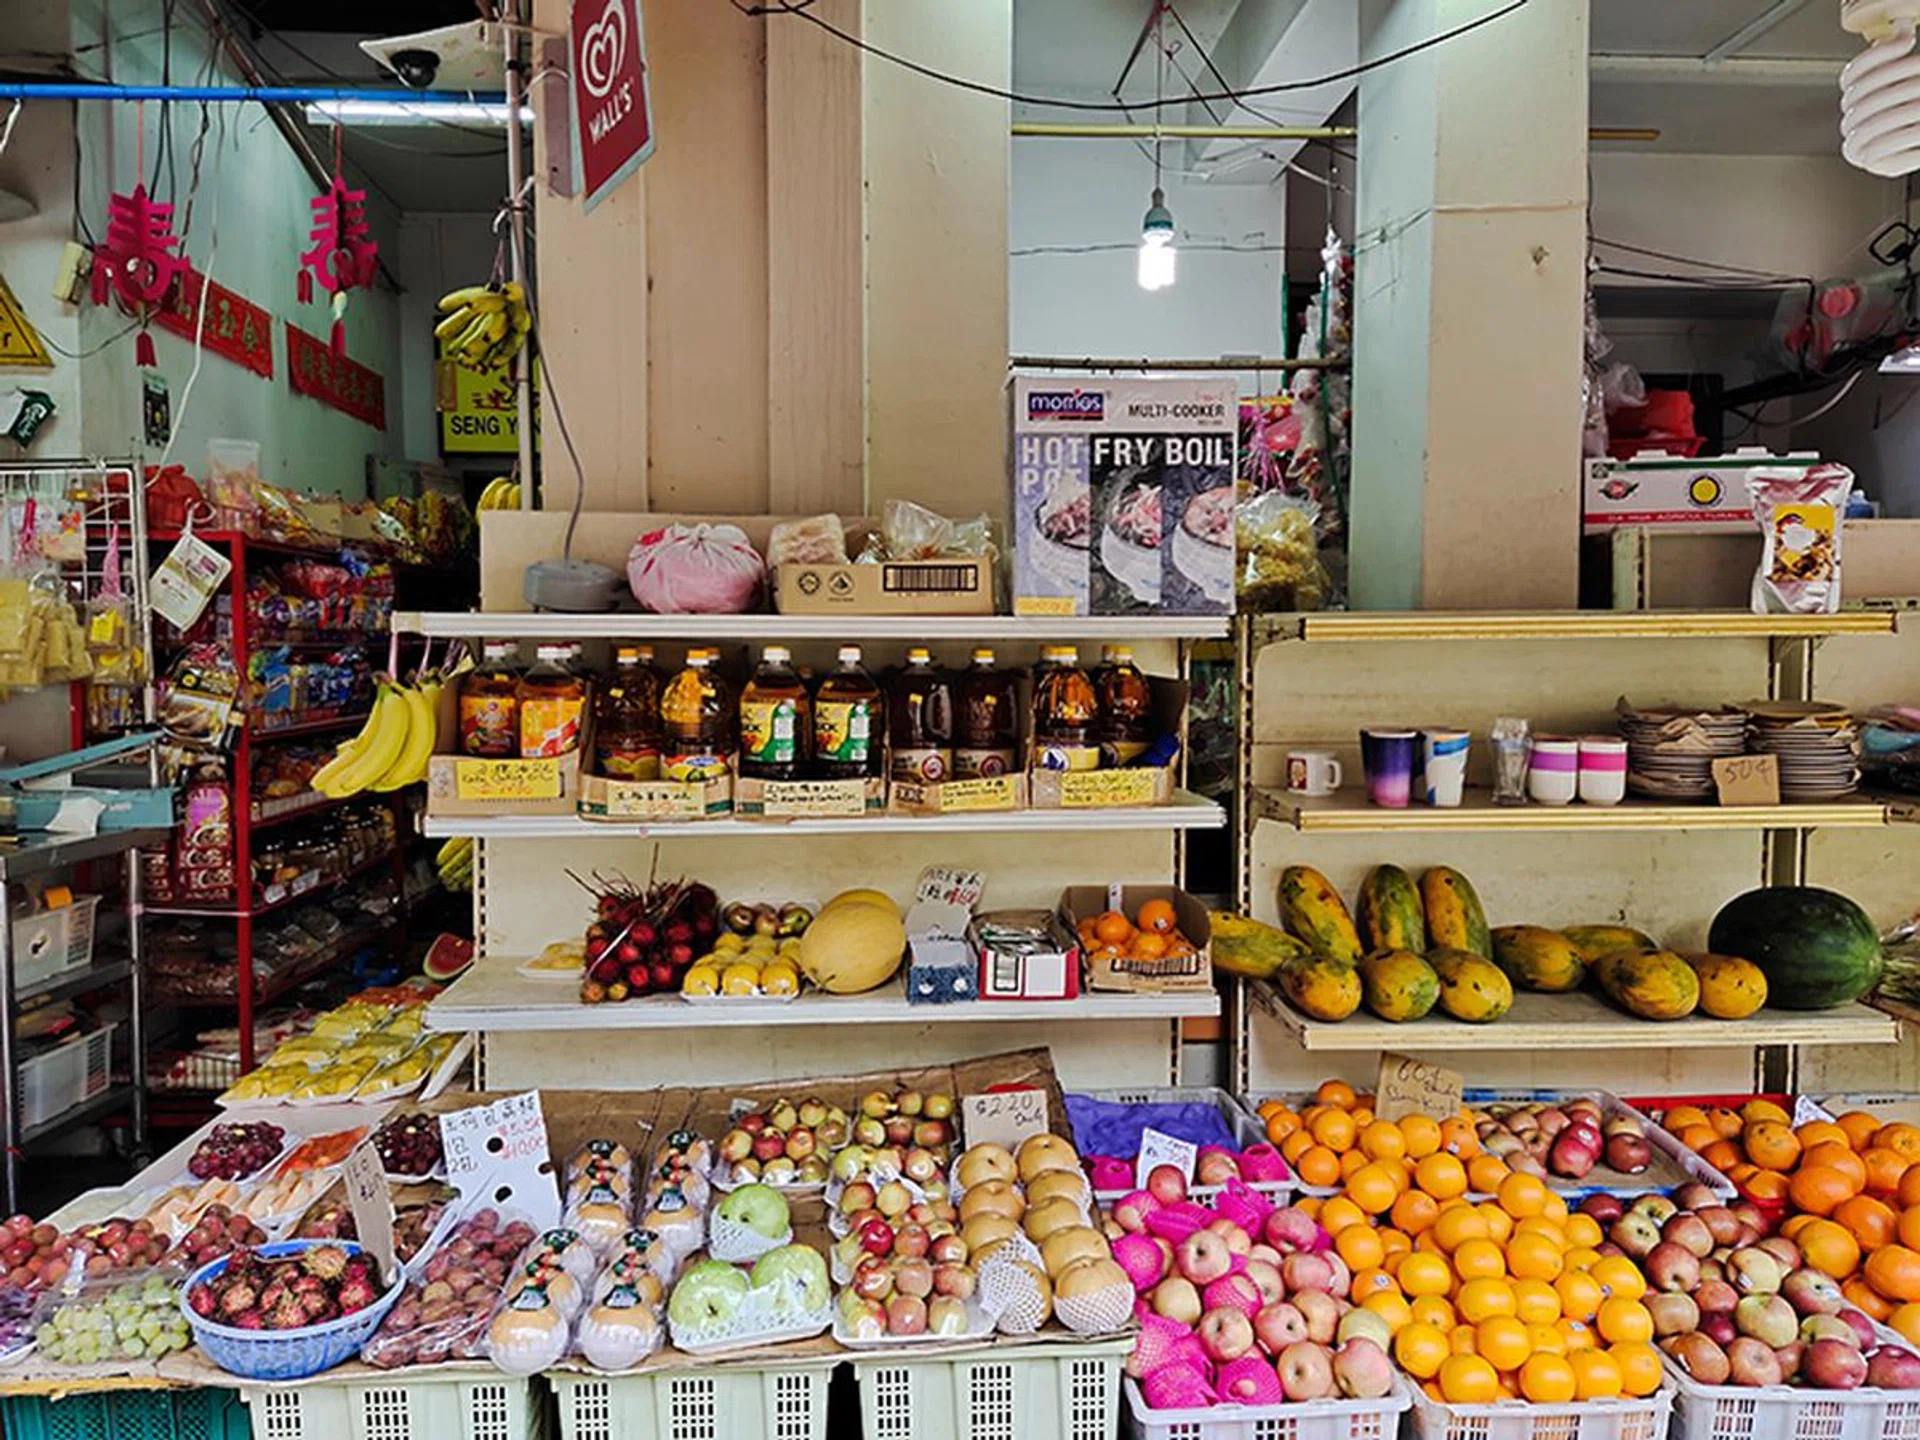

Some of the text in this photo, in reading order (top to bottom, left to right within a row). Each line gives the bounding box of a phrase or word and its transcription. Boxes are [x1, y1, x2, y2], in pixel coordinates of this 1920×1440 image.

[588, 82, 632, 144] WALL'S
[1030, 389, 1101, 411] morries
[1128, 403, 1225, 418] MULTI-COOKER
[451, 415, 499, 435] SENG
[1020, 437, 1231, 466] HOT FRY BOIL
